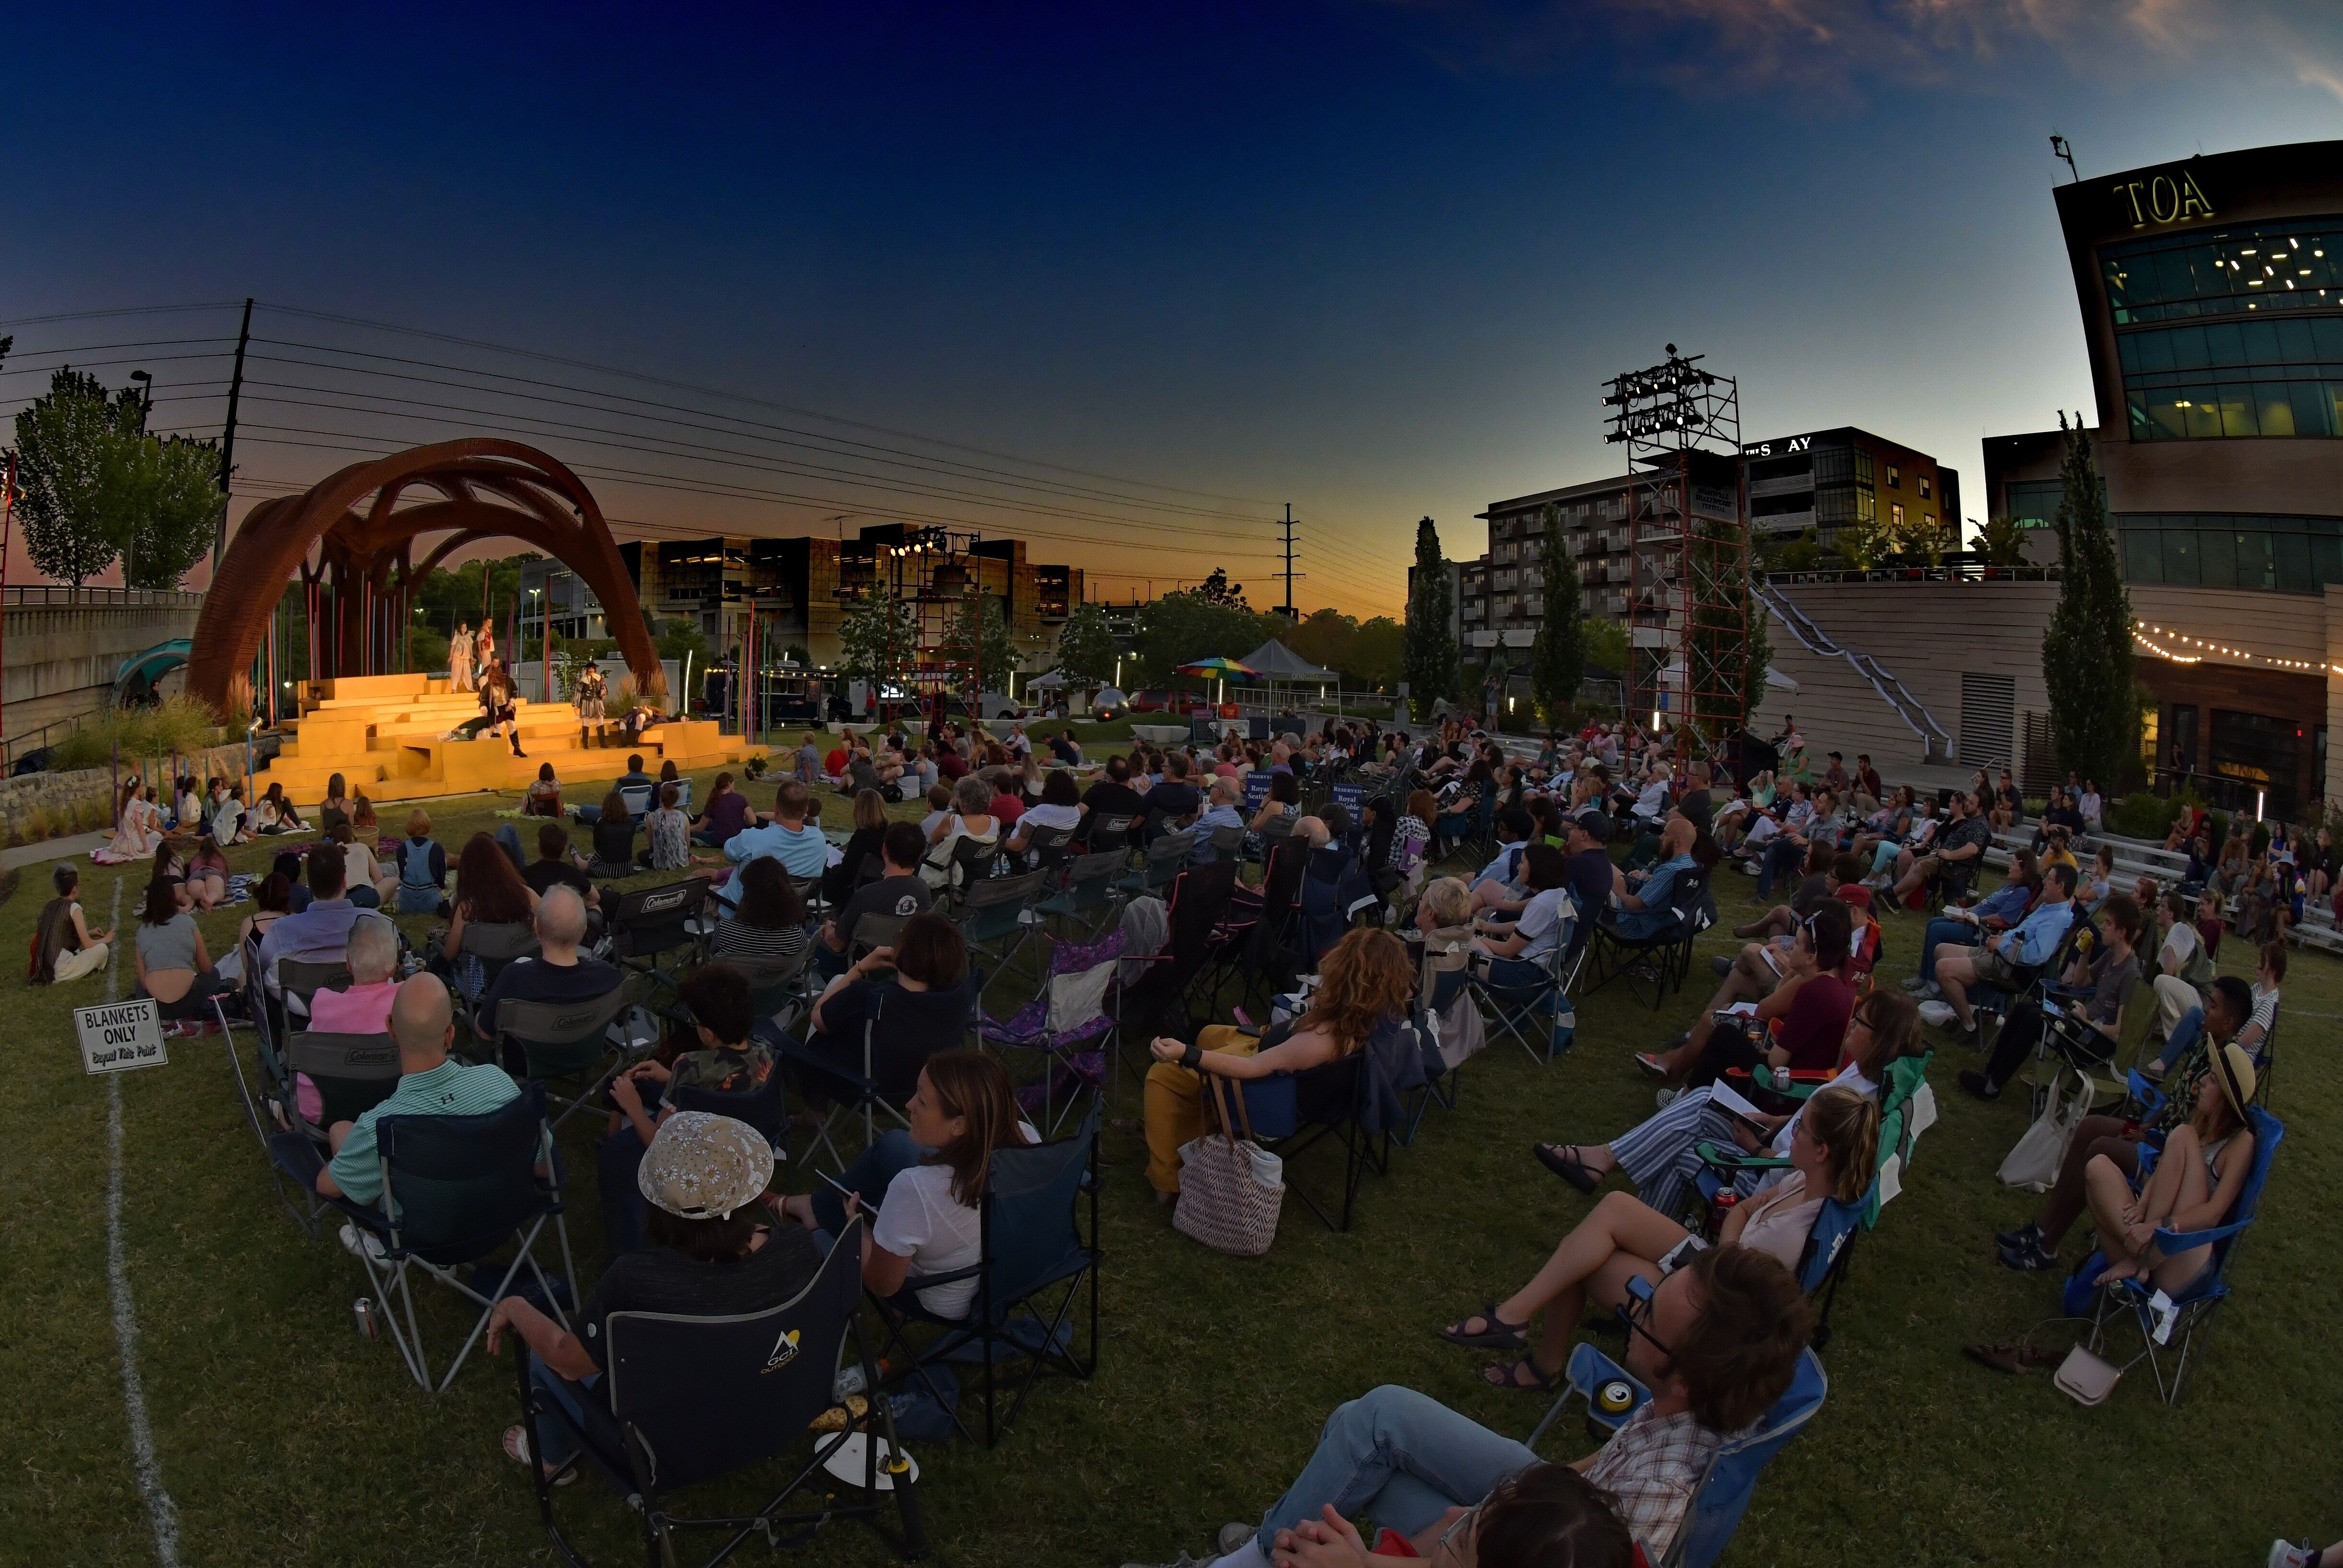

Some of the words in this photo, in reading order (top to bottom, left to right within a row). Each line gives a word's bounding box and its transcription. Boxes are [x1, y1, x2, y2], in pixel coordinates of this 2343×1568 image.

[2112, 168, 2217, 229] TOA
[1251, 785, 1269, 793] Royal
[1338, 795, 1356, 804] Royal
[647, 897, 677, 909] Coleman
[85, 1005, 149, 1029] BLANKETS
[558, 1015, 591, 1027] Coleman
[104, 1025, 136, 1045] ONLY
[92, 1049, 117, 1067] Beyond
[118, 1047, 135, 1060] This
[136, 1043, 157, 1057] Point
[351, 1050, 388, 1061] Coleman
[767, 1346, 794, 1366] GCI
